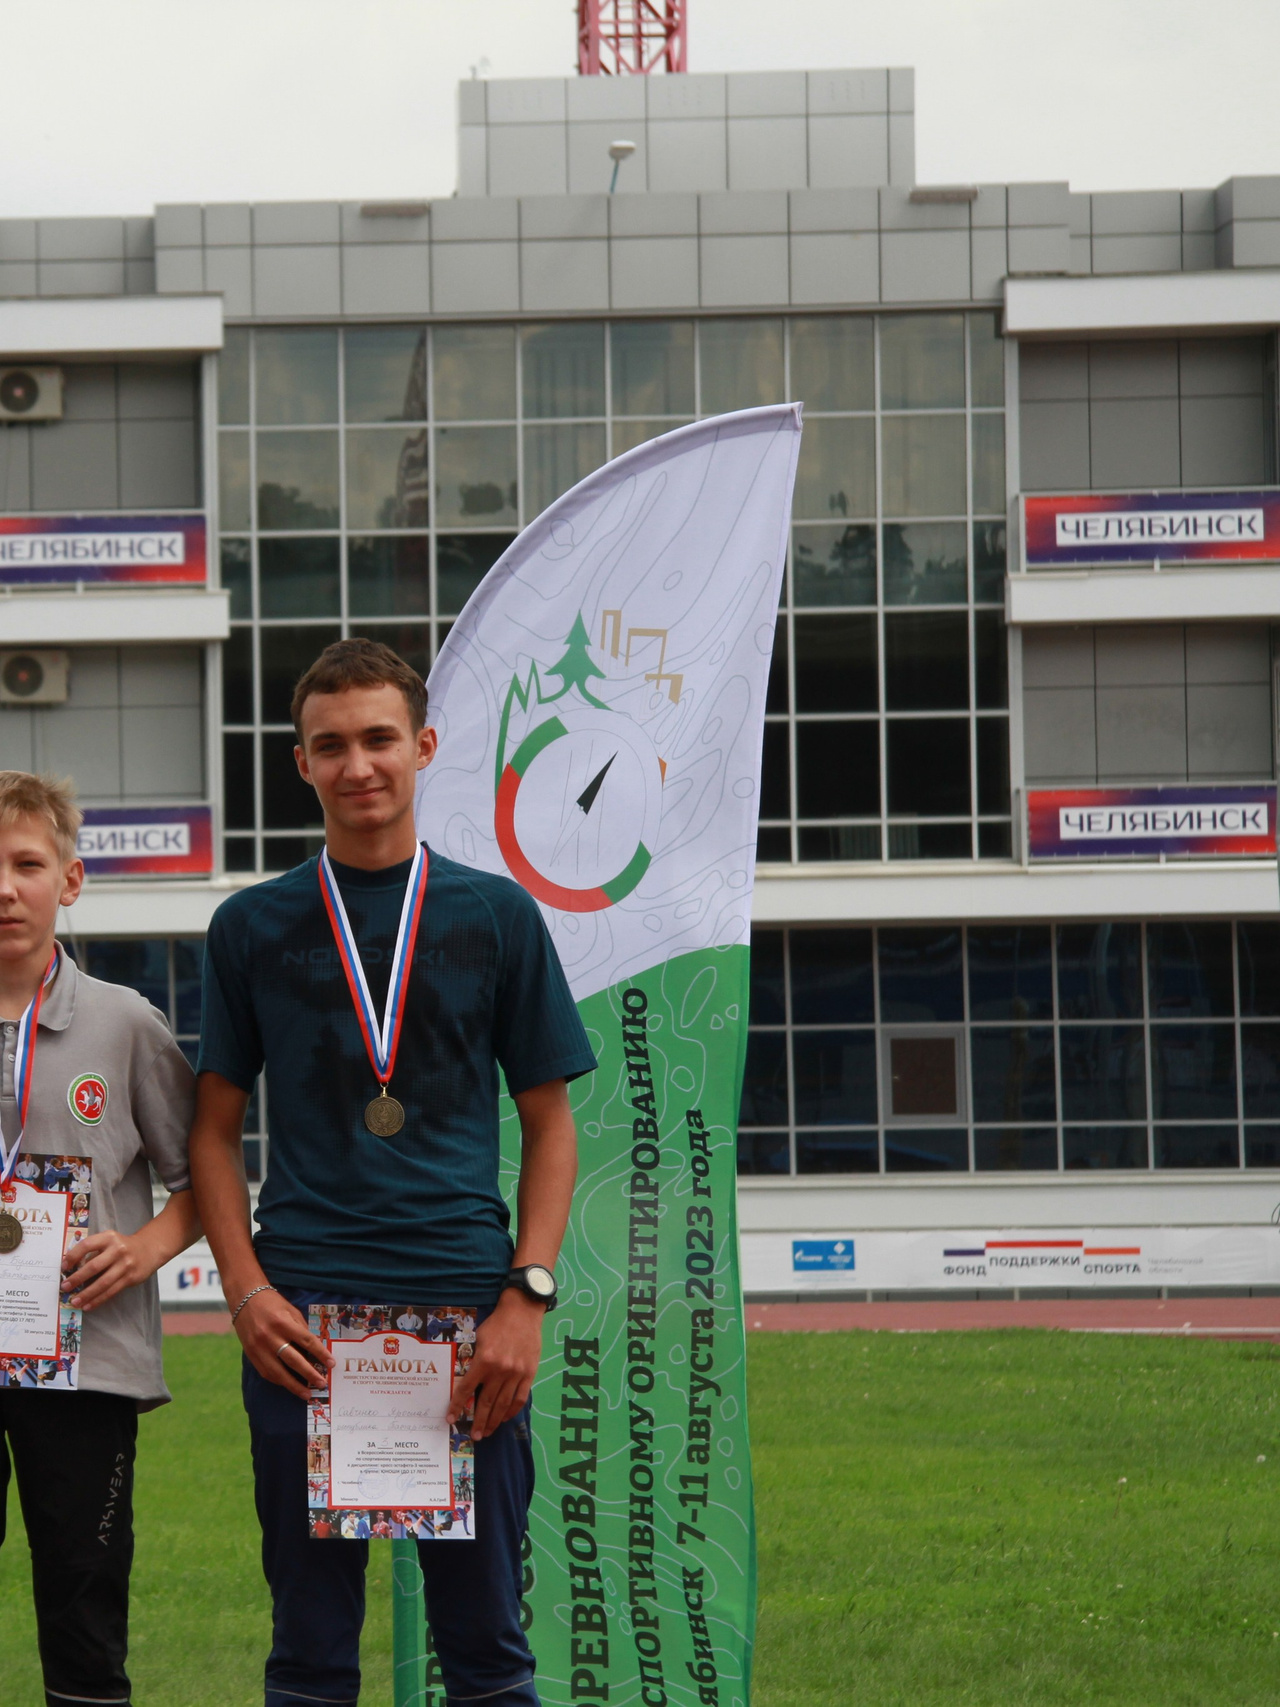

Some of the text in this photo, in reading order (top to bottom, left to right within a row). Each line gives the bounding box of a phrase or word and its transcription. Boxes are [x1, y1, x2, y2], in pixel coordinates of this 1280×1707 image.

[1061, 514, 1258, 540] ЧЕЛЯБИНСК
[1065, 808, 1263, 834] ЧЕЛЯБИНСК
[281, 946, 446, 967] NODKI
[943, 1256, 1141, 1276] ФОНД ПОДДЕРЖКИ СПОРТА
[622, 987, 668, 1707] СПОРТИВНОМУ ОРИЕНТИРОВАНИЮ
[344, 1357, 438, 1374] ГРАМОТА
[676, 1108, 721, 1707] ябинск 7-11 августа 2023 года
[97, 1452, 125, 1546] ARSIVEAR
[559, 1335, 610, 1707] РЕВНОВАНИЯ
